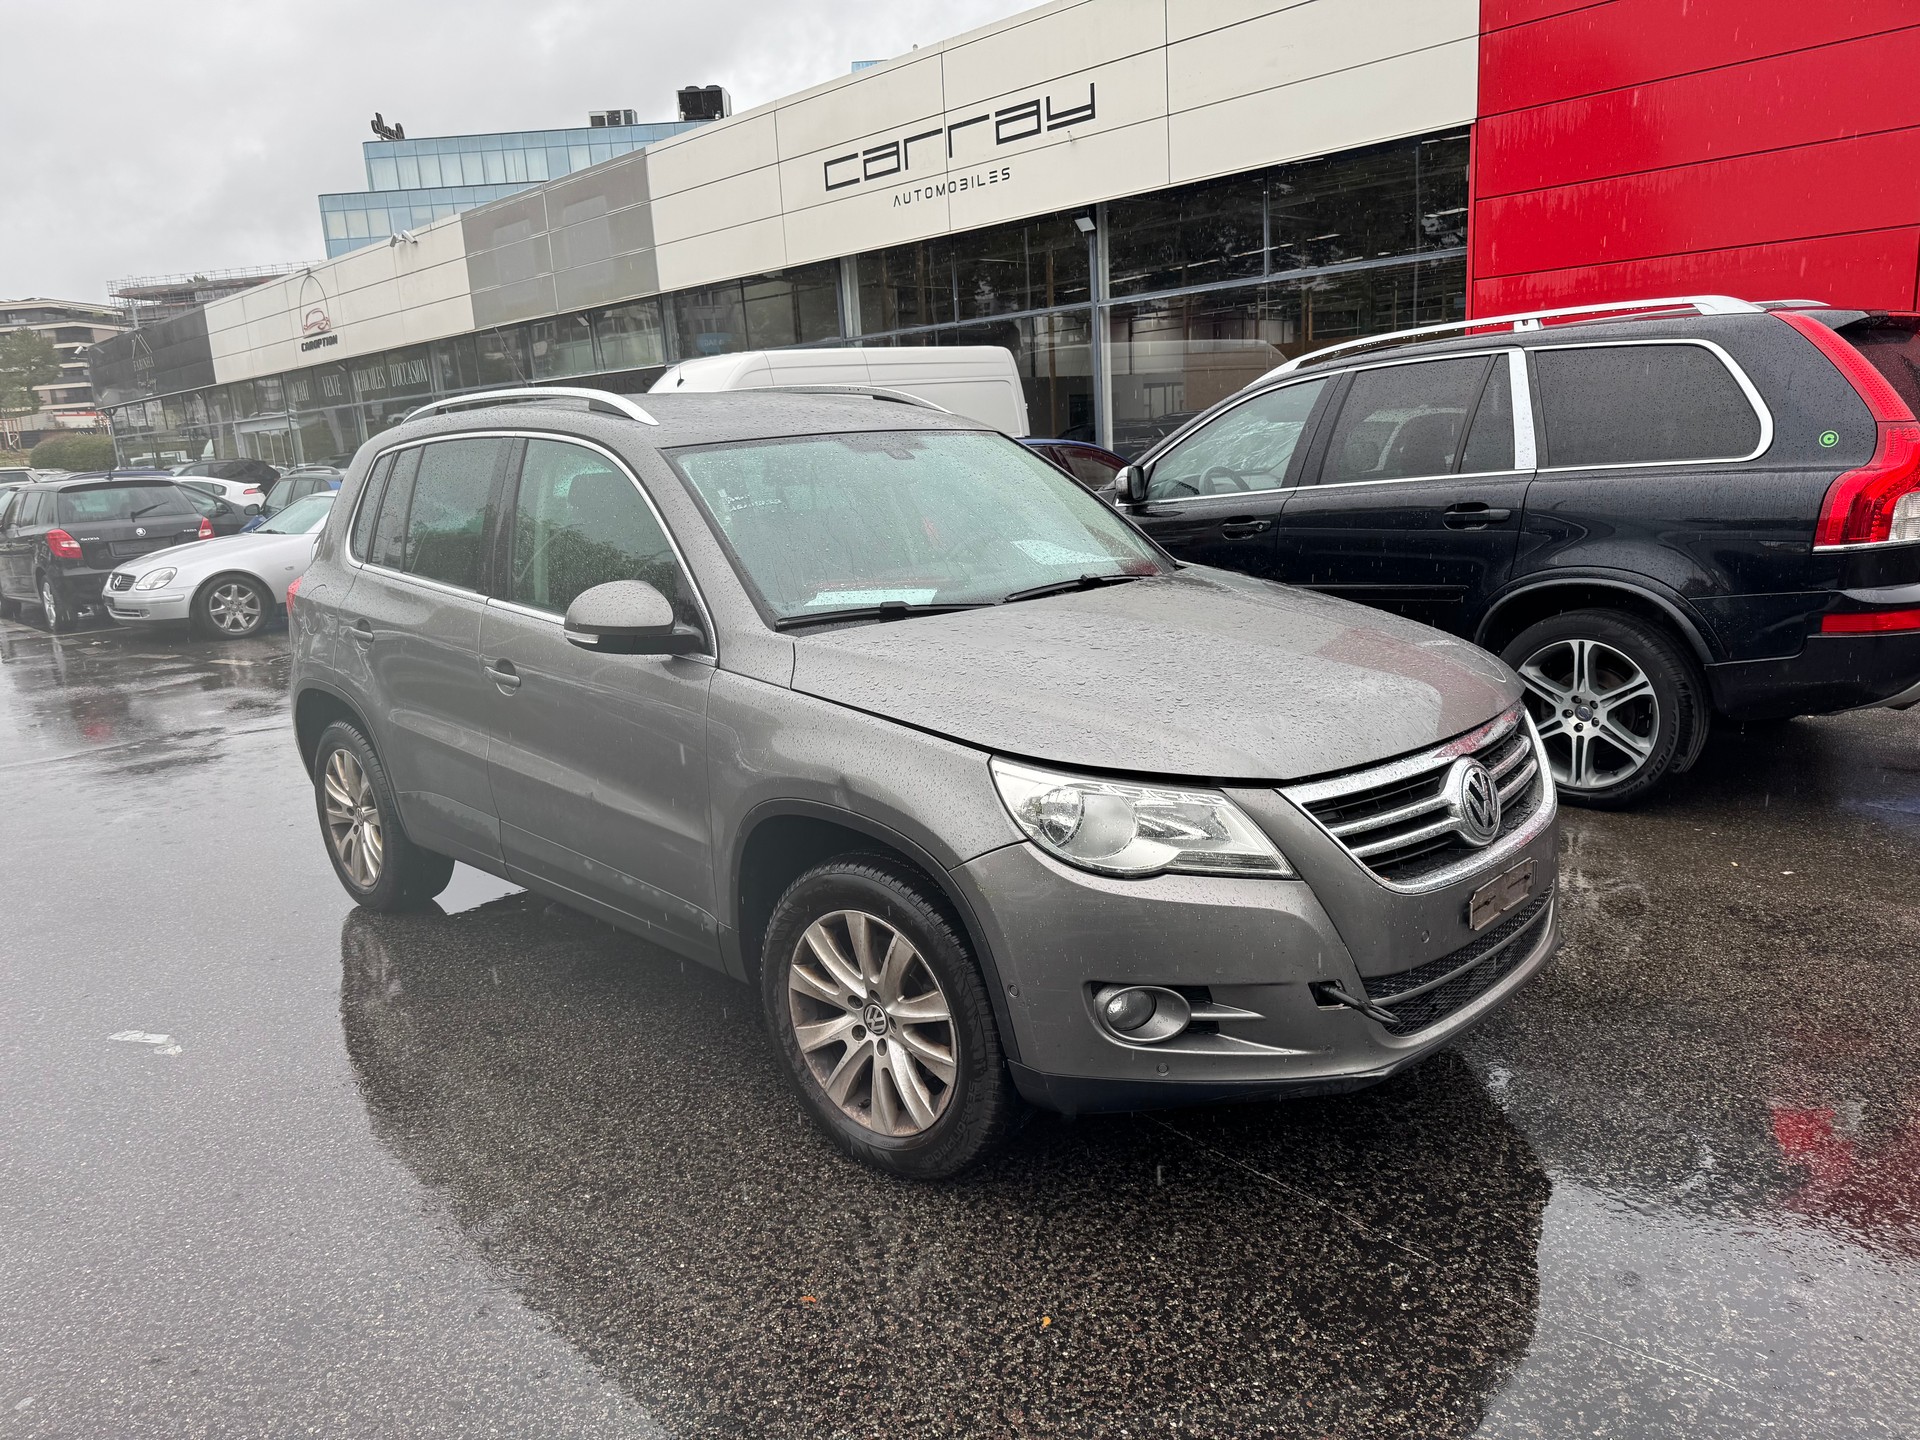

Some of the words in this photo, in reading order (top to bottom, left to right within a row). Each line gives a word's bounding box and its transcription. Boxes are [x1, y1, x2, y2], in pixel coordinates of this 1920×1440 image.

[824, 82, 1096, 192] carray
[893, 167, 1011, 207] AUTOMOBILES
[321, 373, 343, 398] VENTE
